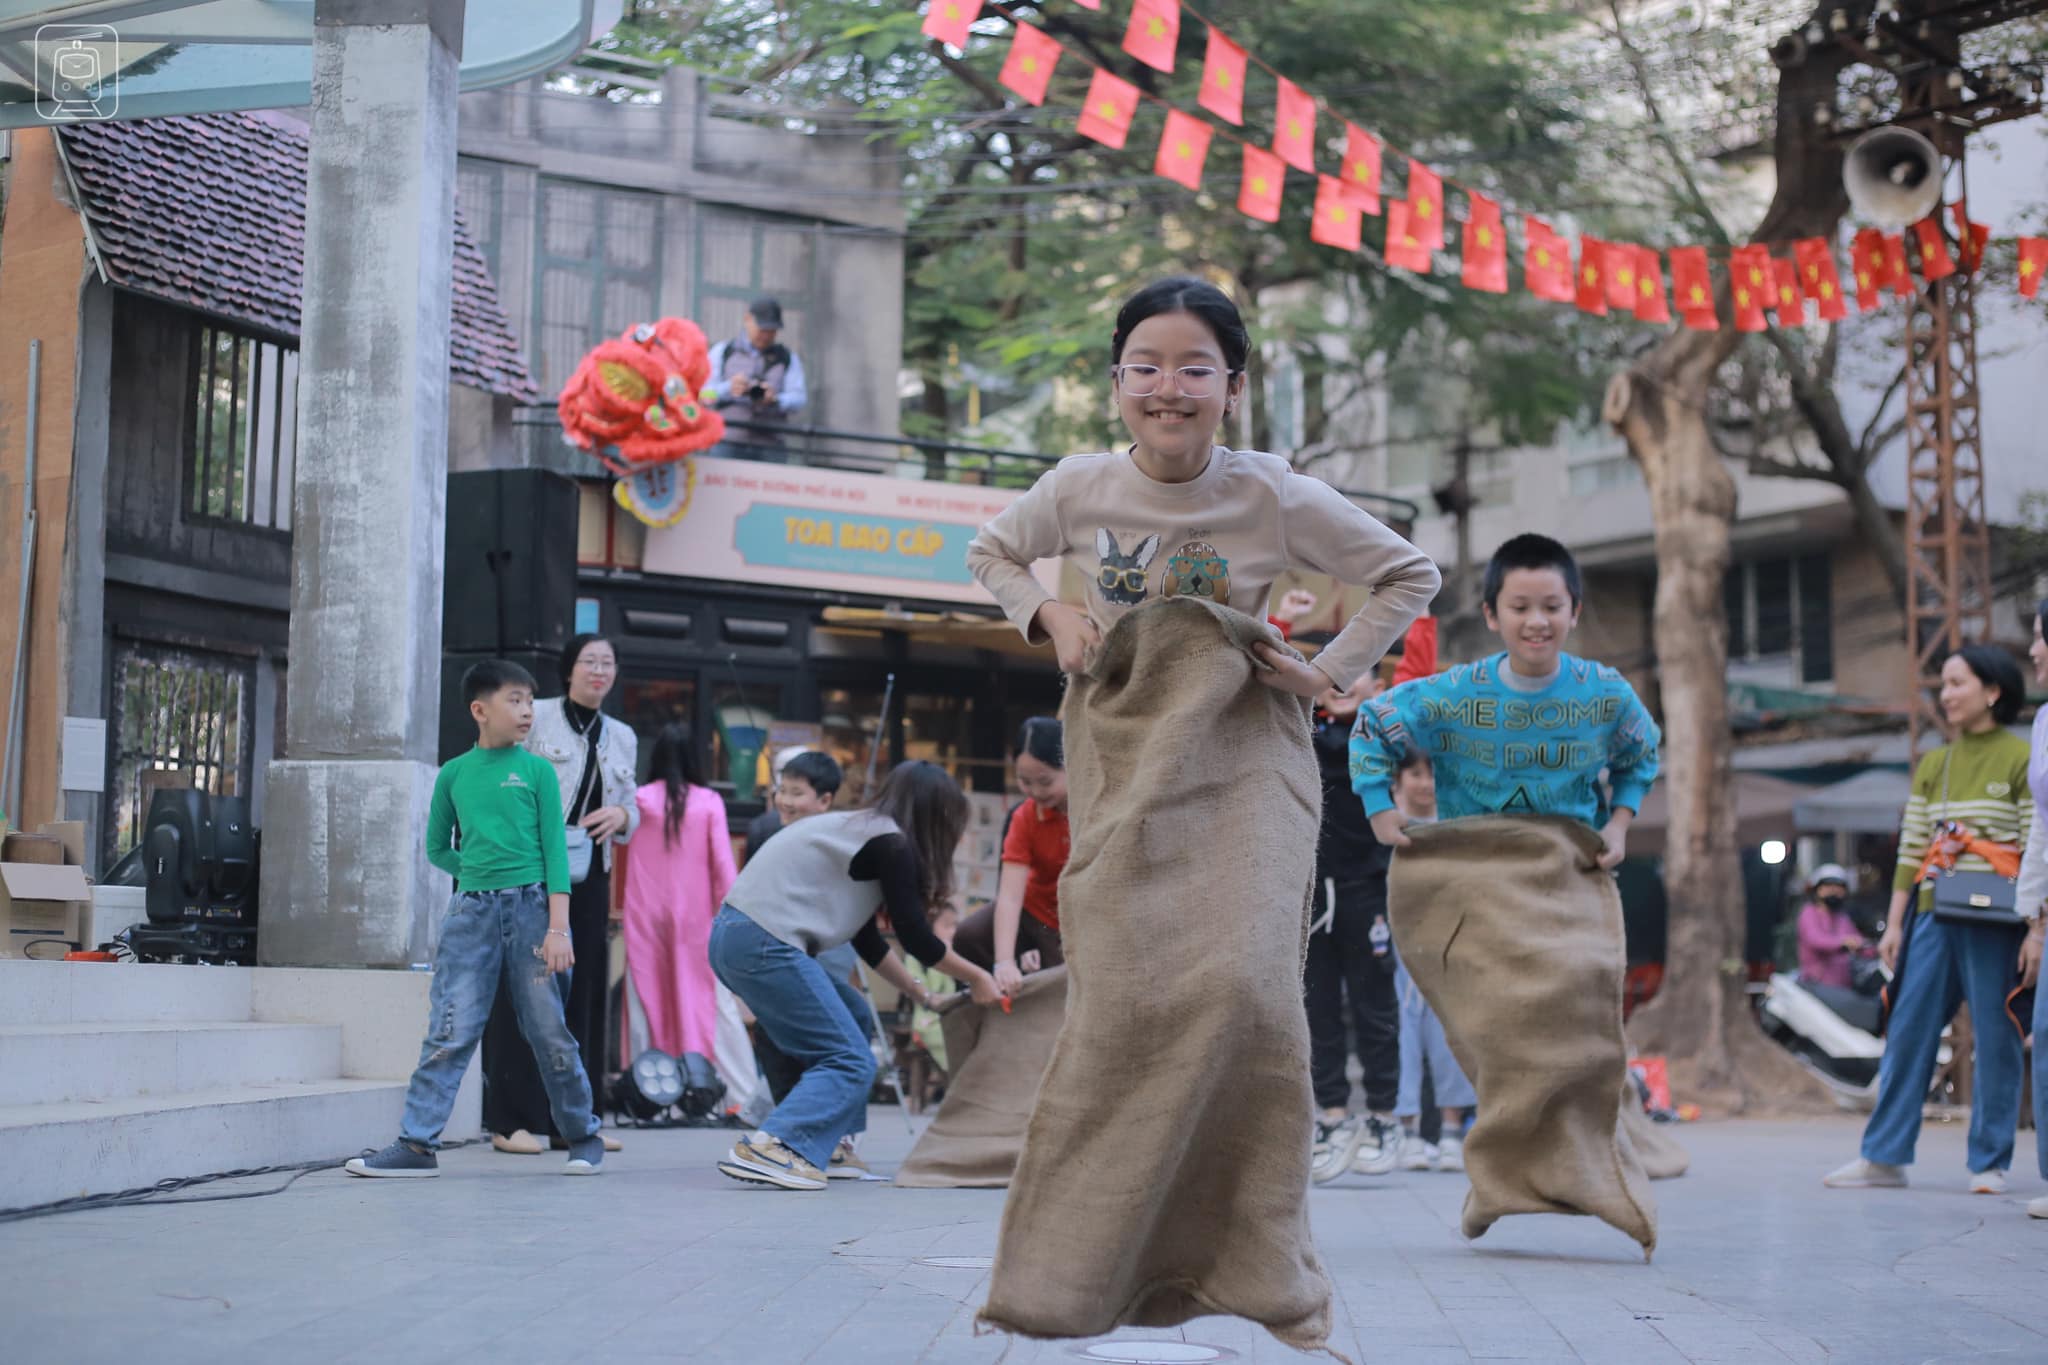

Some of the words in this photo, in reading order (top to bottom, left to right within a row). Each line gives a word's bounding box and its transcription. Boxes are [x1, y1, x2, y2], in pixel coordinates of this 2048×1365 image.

[785, 517, 832, 547] TOA
[840, 523, 890, 553] BAO
[1503, 696, 1621, 729] SOME
